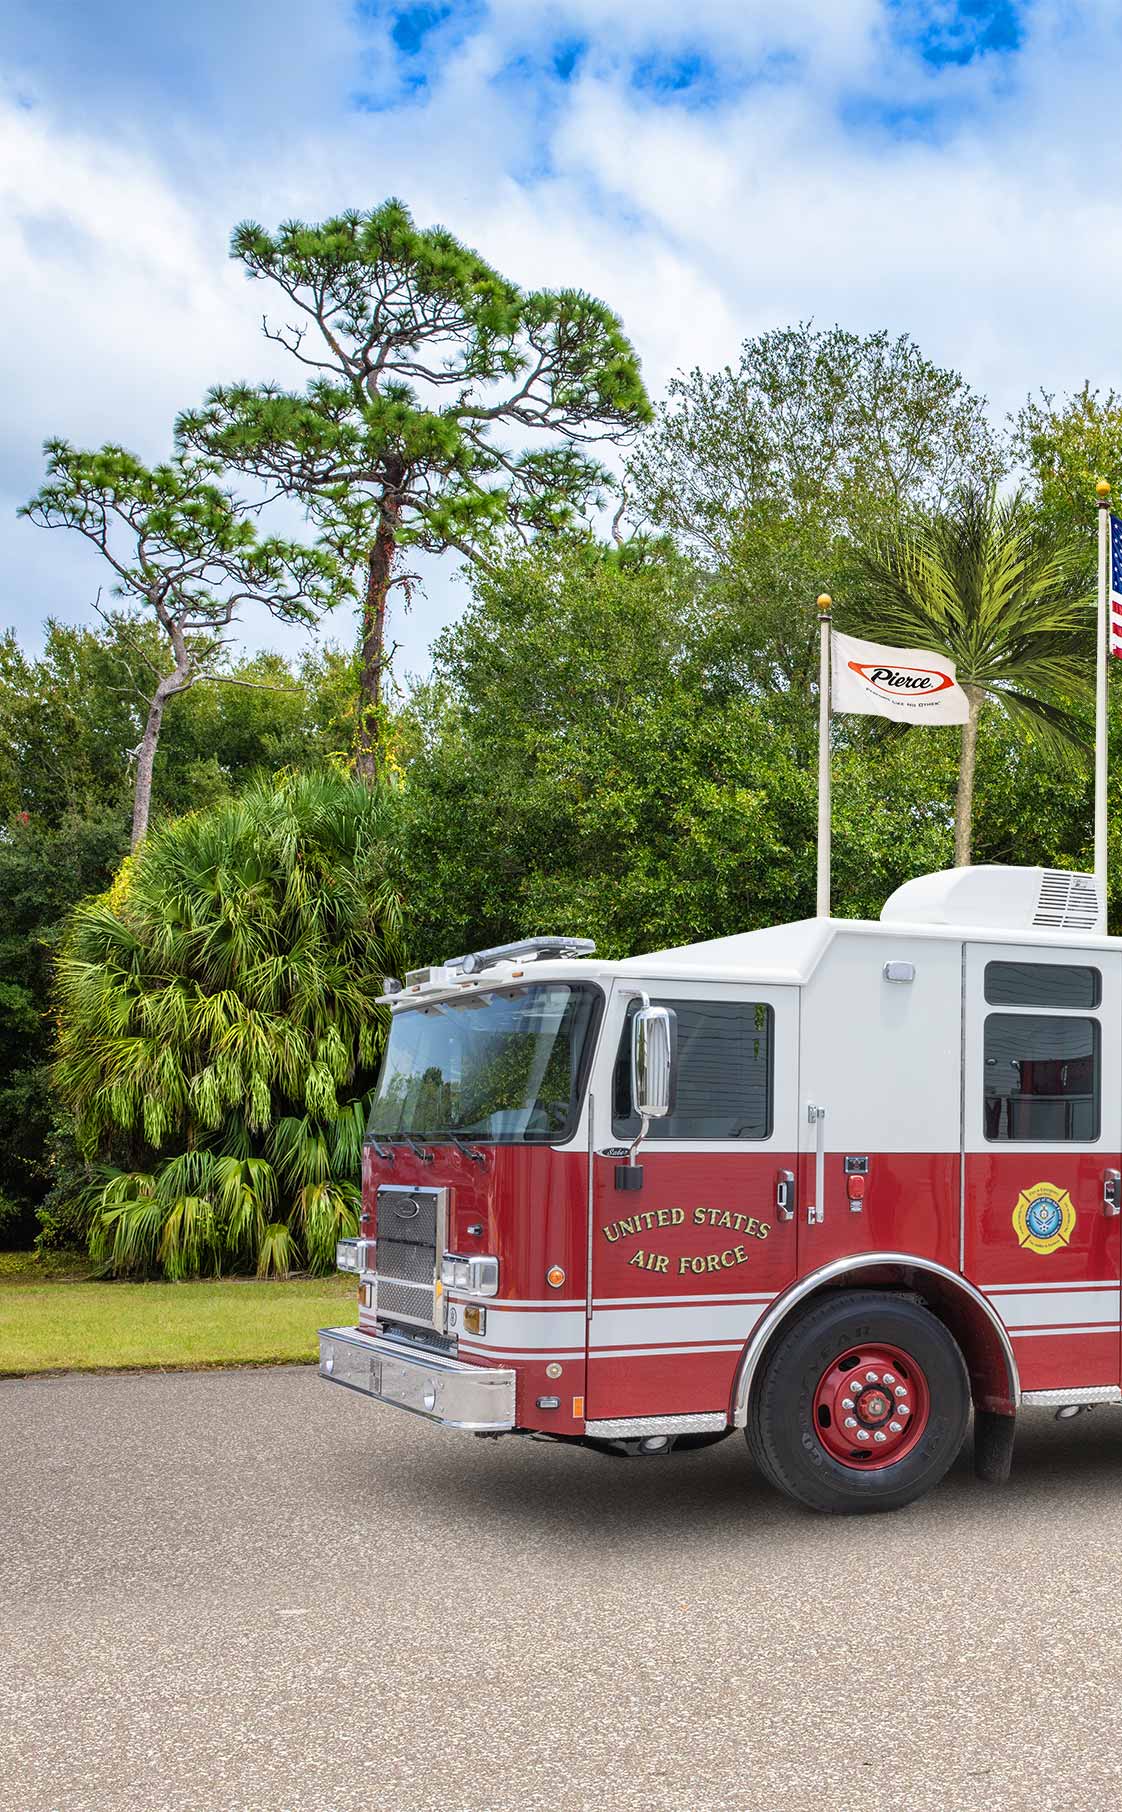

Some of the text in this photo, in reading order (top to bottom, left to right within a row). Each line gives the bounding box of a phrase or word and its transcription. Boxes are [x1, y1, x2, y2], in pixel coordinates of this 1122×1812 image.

[871, 668, 931, 688] Pierce
[602, 1207, 772, 1243] UNITED STATES
[628, 1244, 749, 1276] AIR FORCE
